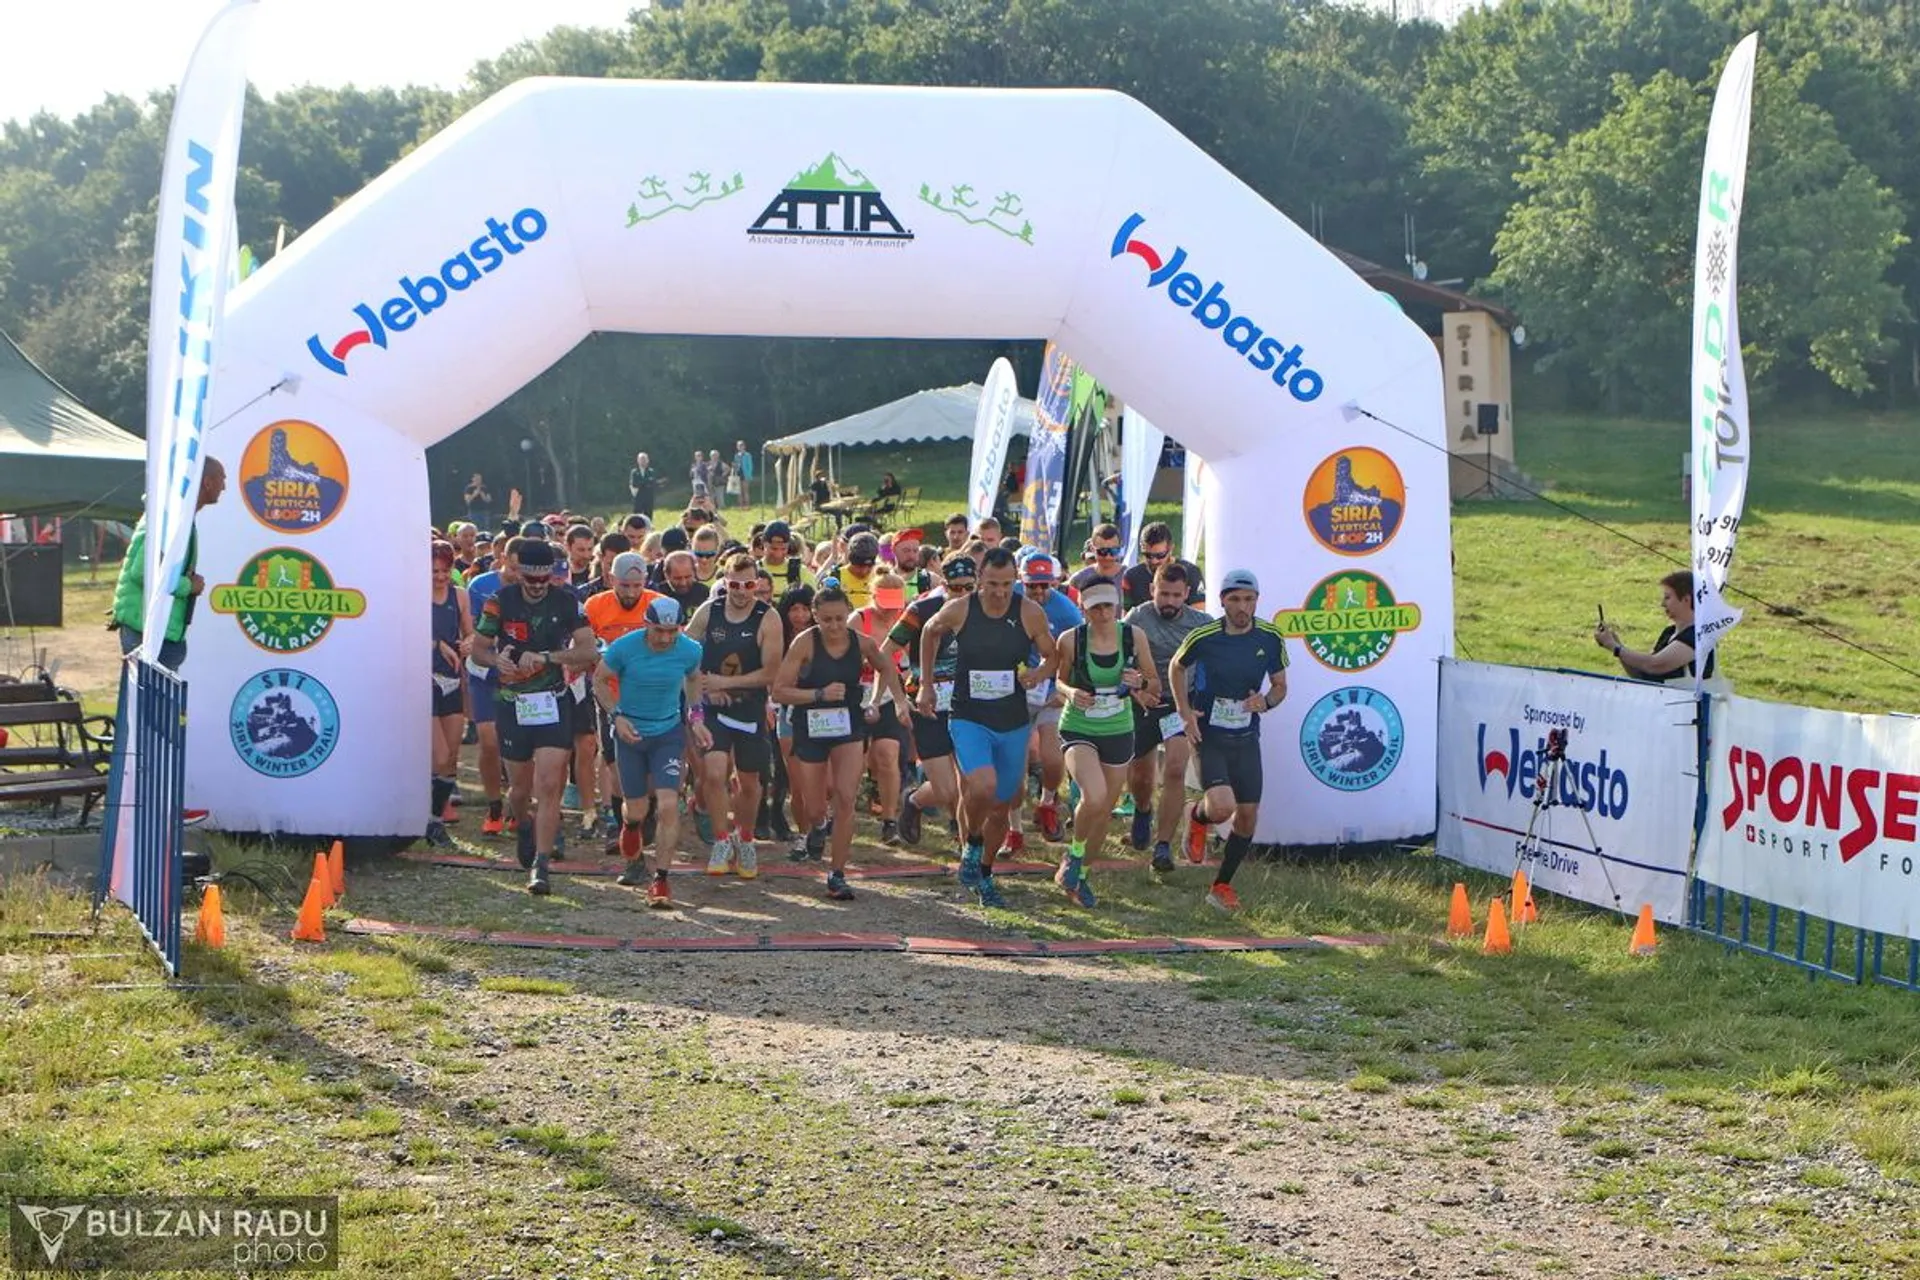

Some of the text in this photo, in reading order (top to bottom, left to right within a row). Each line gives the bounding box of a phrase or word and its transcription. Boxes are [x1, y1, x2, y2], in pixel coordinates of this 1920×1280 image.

[801, 236, 845, 247] Turistica
[307, 208, 547, 376] Webasto
[1111, 212, 1325, 402] Webasto
[264, 480, 320, 499] SIRIA
[265, 498, 321, 510] VERTICAL
[1331, 504, 1383, 522] SIRIA
[1331, 521, 1383, 532] VERTICAL
[221, 588, 352, 613] MEDIEVAL
[241, 612, 328, 650] TRAIL RACE
[1287, 607, 1410, 633] MEDIEVAL
[1310, 632, 1393, 669] TRAIL RACE
[261, 672, 306, 691] SWT
[1332, 690, 1373, 708] SWT
[1524, 704, 1585, 734] Sponsored by
[255, 755, 308, 773] WINTER
[308, 723, 335, 763] TRAIL
[1328, 769, 1379, 787] WINTER
[1379, 734, 1401, 775] TRAIL
[1758, 828, 1828, 861] SPORT
[1551, 851, 1579, 875] Drive
